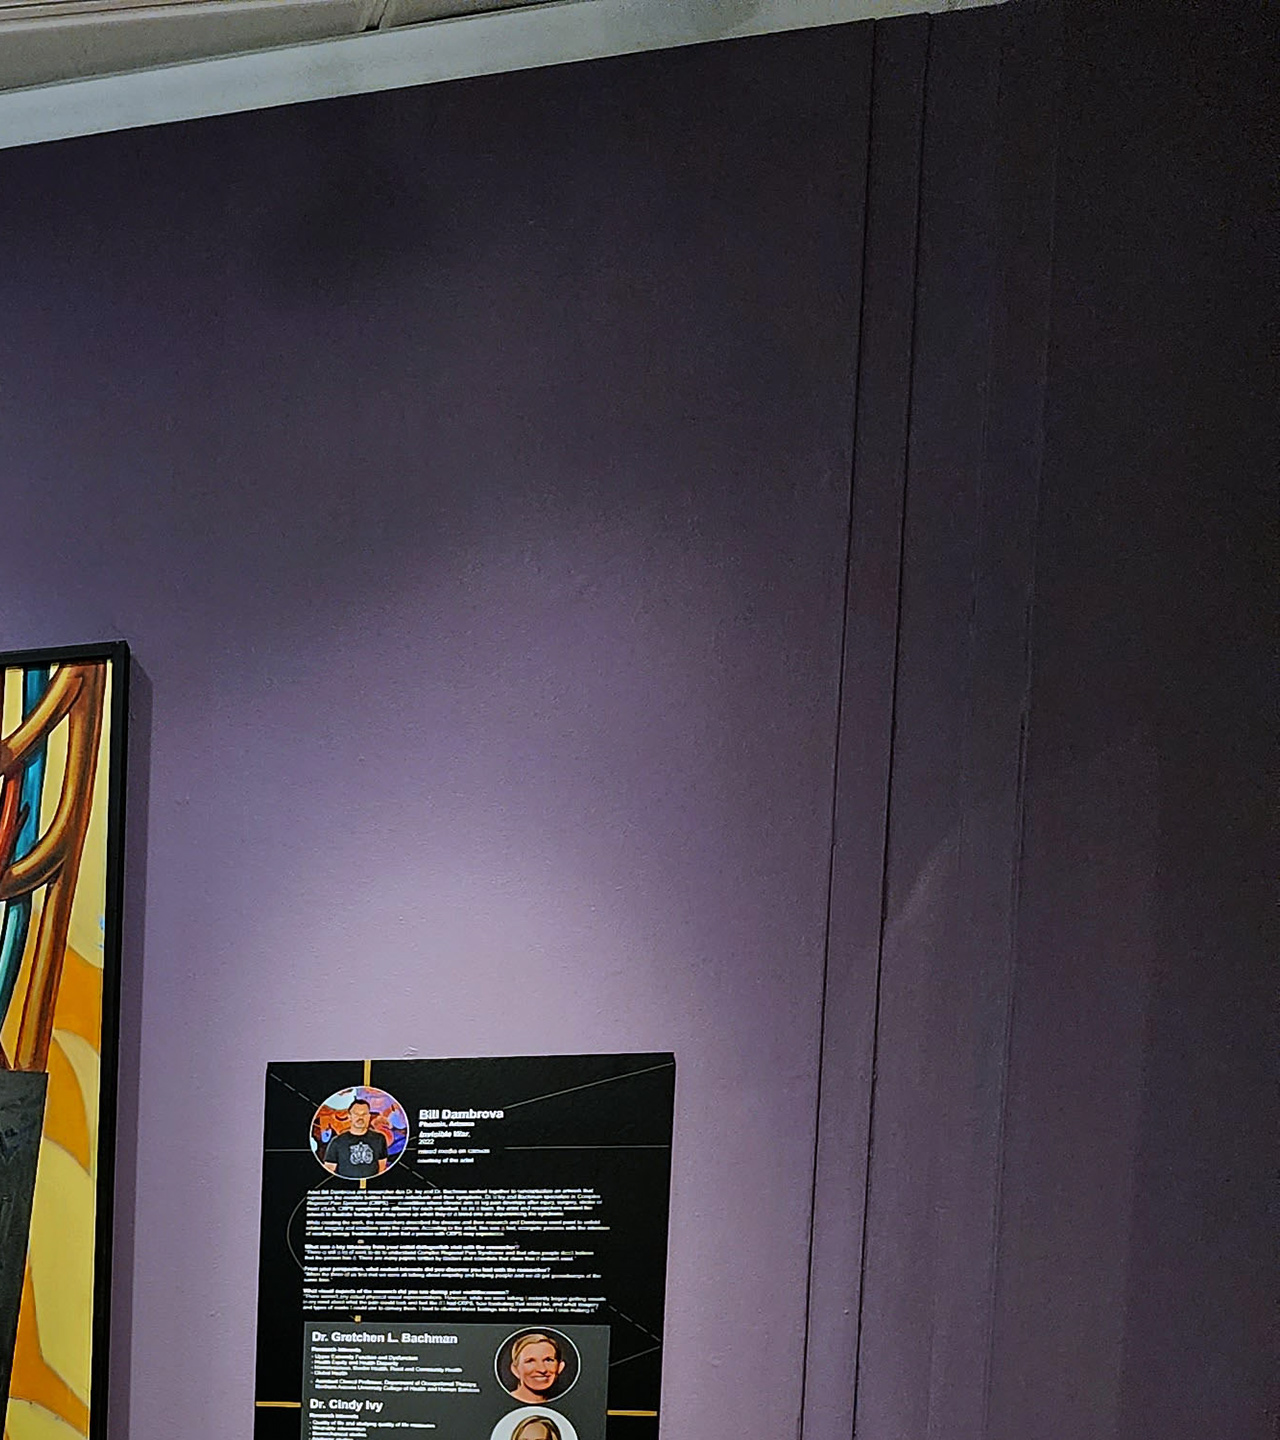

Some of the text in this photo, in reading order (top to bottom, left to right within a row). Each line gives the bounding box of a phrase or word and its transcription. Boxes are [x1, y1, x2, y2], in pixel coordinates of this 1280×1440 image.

[419, 1108, 504, 1119] Bill Dambrova
[311, 1331, 329, 1342] Dr.
[387, 1332, 399, 1343] L.
[401, 1332, 458, 1344] Bachman
[309, 1398, 384, 1412] Dr. Cindy Ivy
